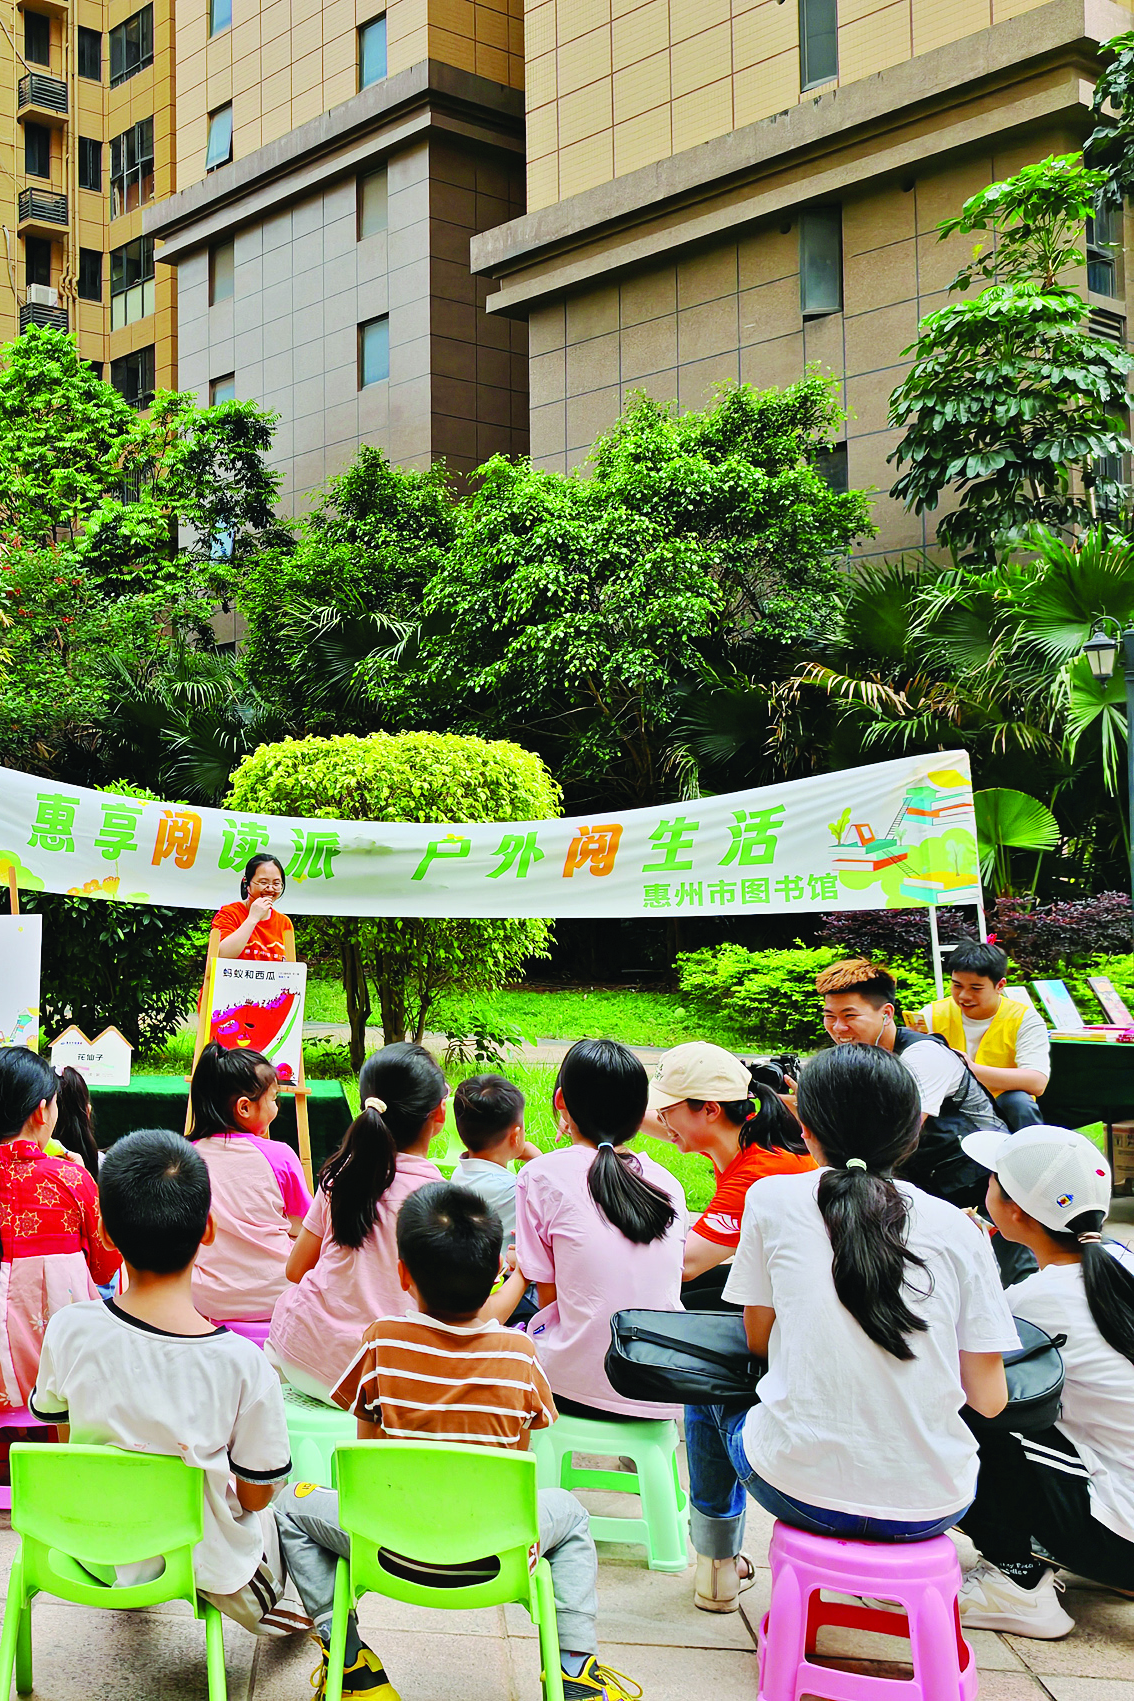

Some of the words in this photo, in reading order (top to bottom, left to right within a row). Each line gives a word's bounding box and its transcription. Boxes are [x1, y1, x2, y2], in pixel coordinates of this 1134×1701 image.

[27, 792, 341, 881] 惠享阅读派
[411, 803, 787, 881] 户外阅生活
[642, 872, 839, 909] 惠州市图书馆
[222, 967, 276, 981] 蚂蚁和西瓜
[77, 1053, 104, 1062] 花仙子
